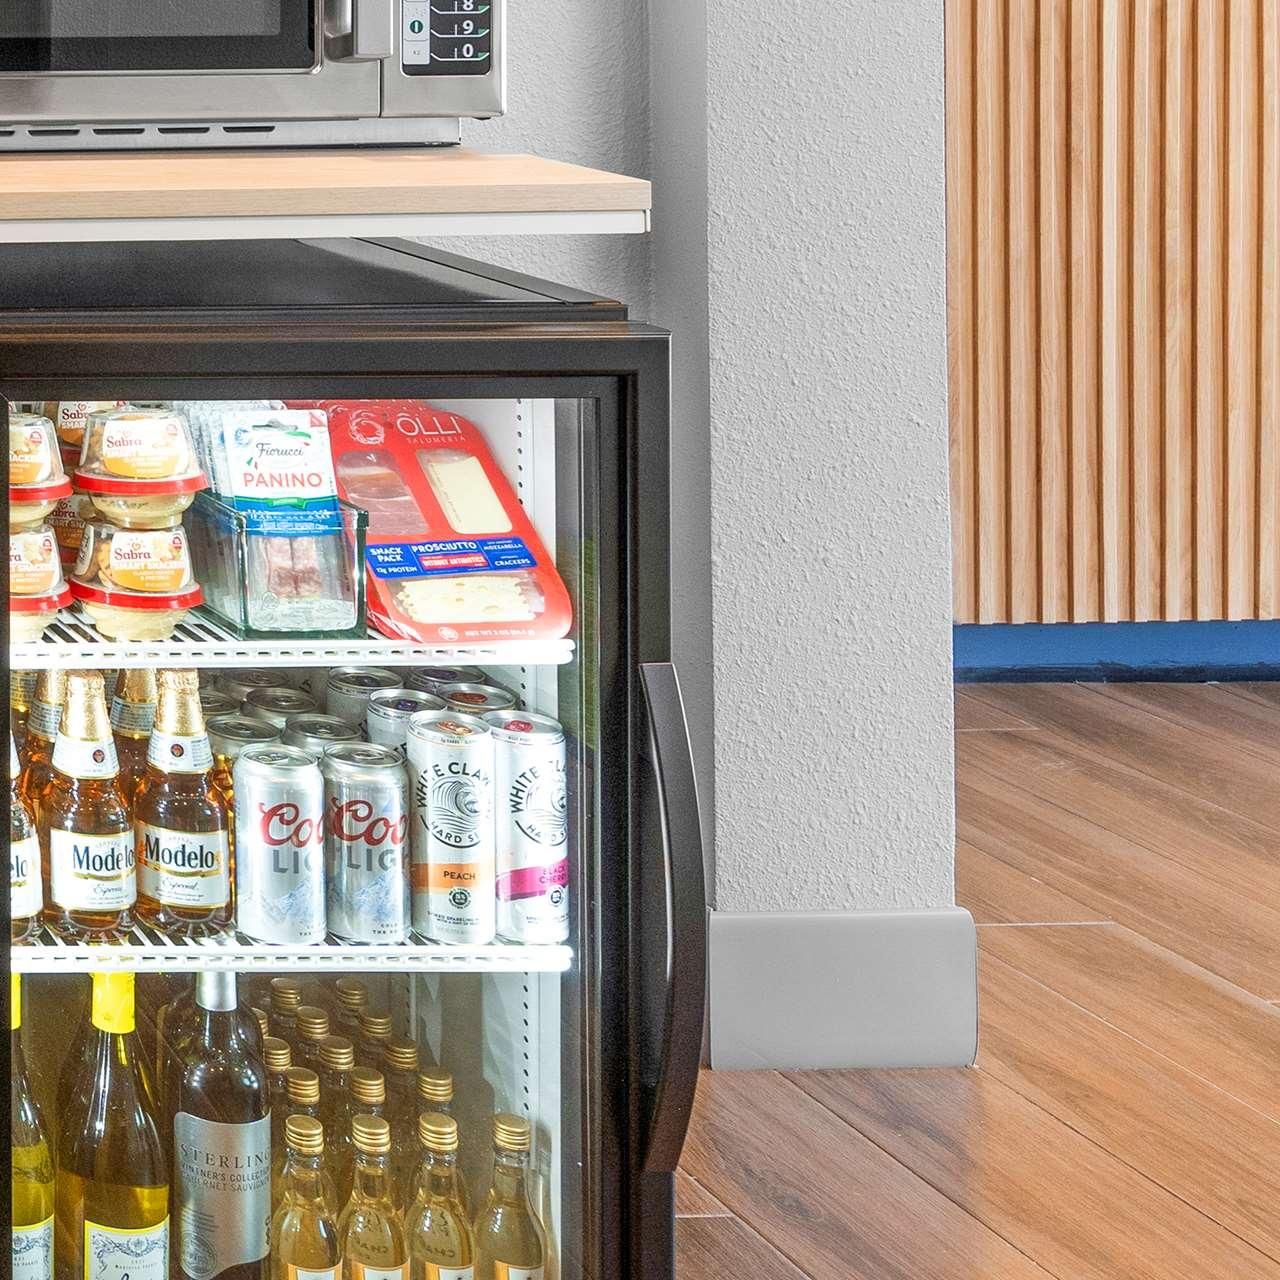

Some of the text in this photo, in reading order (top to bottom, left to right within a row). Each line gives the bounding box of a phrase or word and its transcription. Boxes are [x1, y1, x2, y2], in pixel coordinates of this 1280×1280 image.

[463, 21, 474, 34] 9
[463, 44, 474, 57] 0
[243, 472, 322, 488] PANINO
[412, 541, 477, 553] PROSCIUTTO
[114, 548, 152, 561] Sabra
[72, 844, 134, 870] Modelo
[144, 833, 214, 869] Modelo
[443, 871, 475, 880] PEACH
